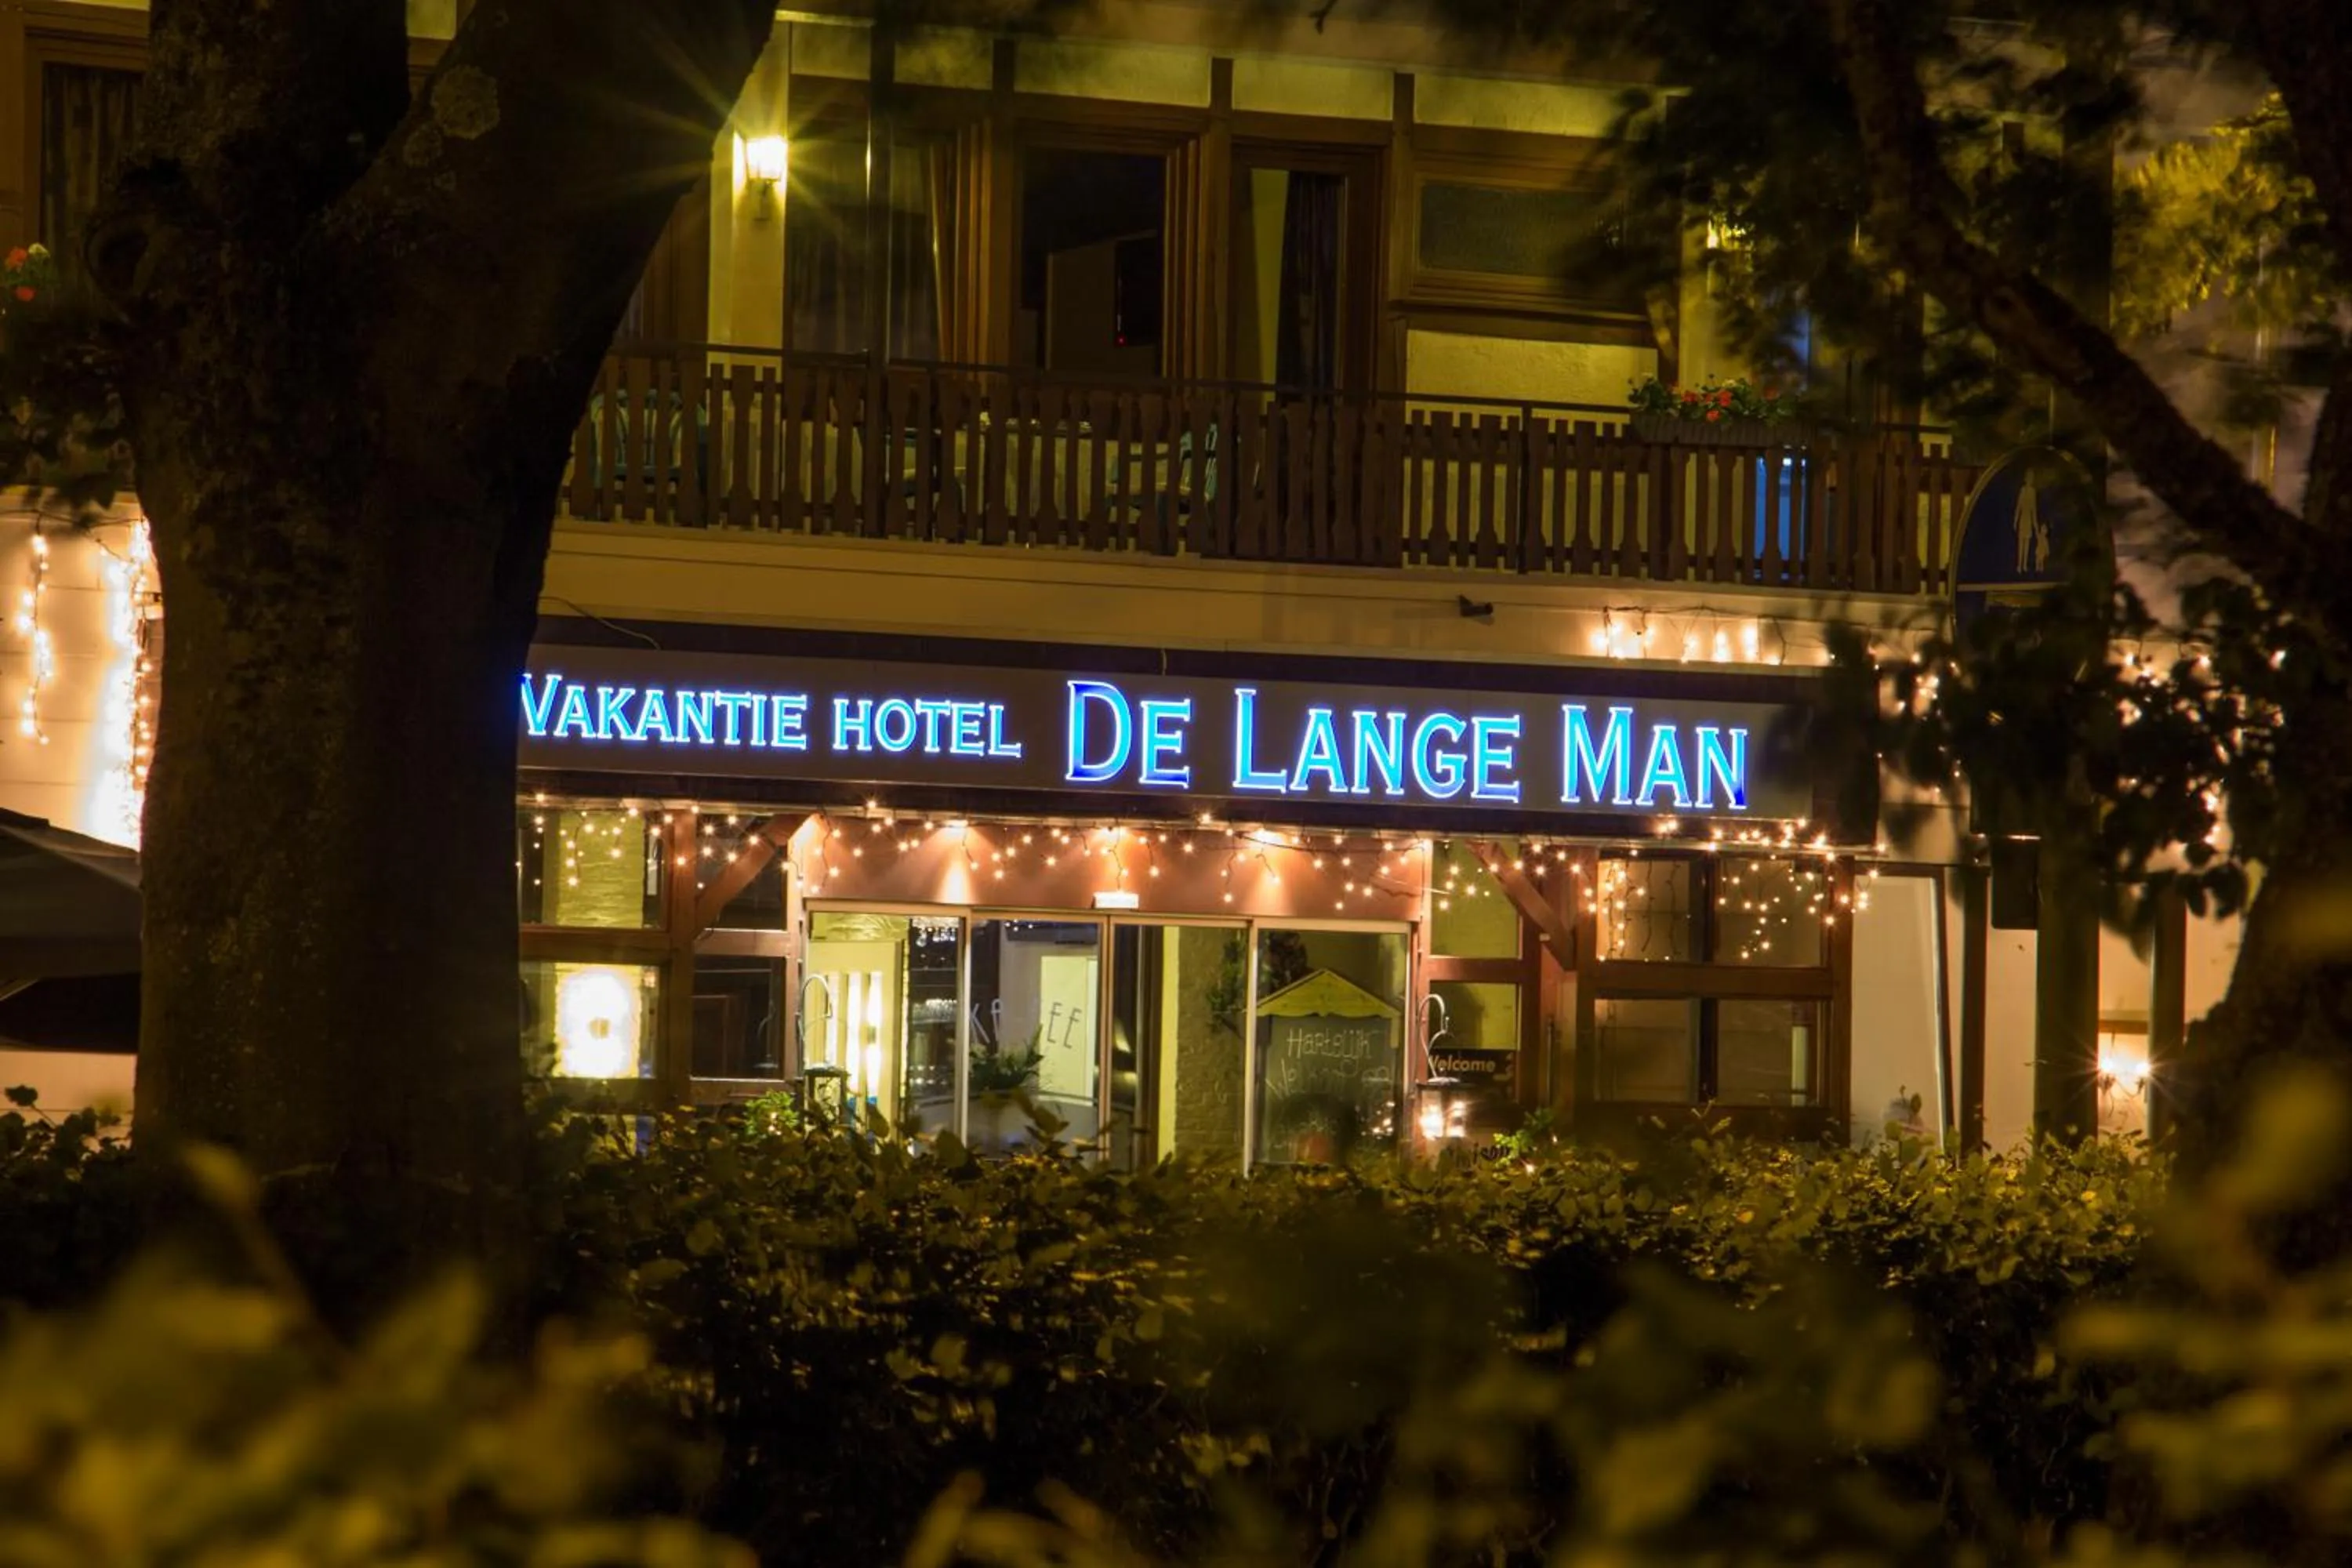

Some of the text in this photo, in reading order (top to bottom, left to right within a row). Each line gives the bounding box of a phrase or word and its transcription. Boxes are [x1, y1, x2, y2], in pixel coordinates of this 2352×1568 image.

[520, 673, 1748, 809] VAKANTIE HOTEL DE LANGE MAN
